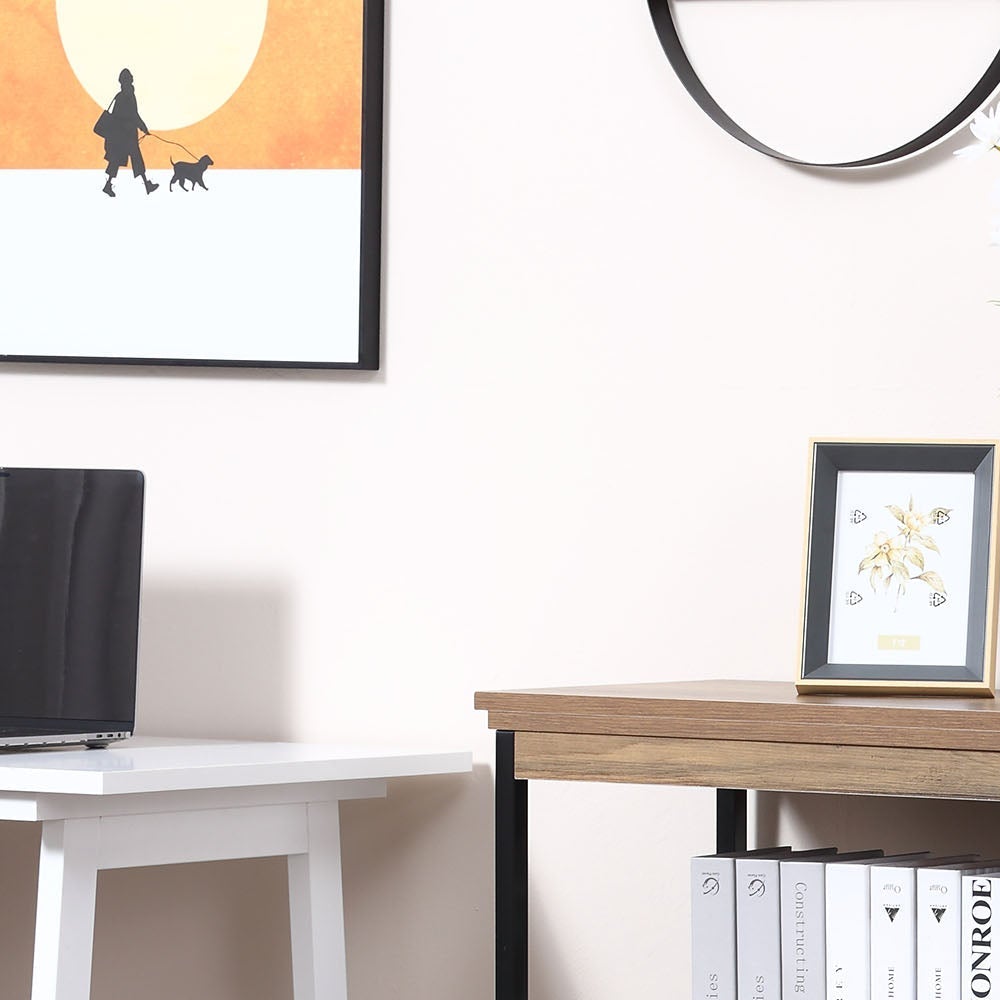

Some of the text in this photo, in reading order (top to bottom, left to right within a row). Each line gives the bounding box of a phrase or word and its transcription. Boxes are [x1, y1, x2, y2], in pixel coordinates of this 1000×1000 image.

[795, 882, 808, 994] Constructing
[887, 966, 896, 998] HOME
[934, 967, 943, 999] HOME
